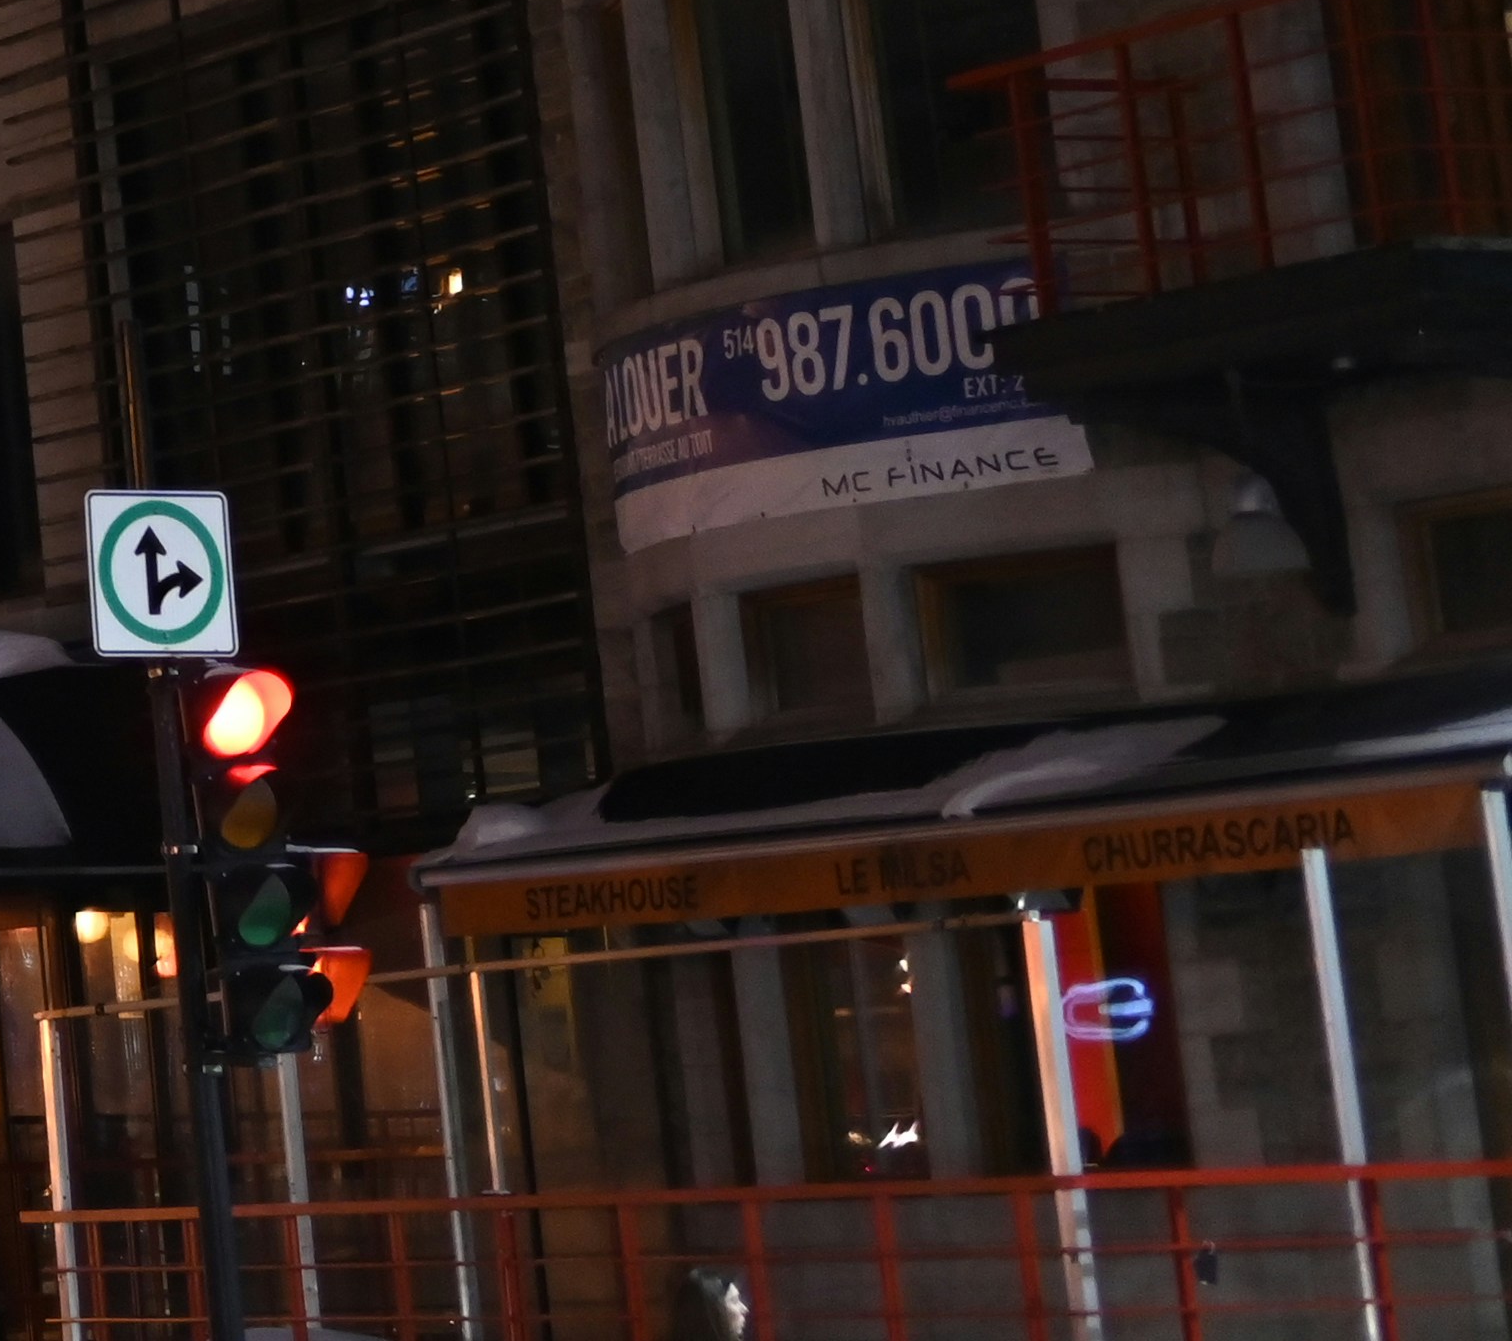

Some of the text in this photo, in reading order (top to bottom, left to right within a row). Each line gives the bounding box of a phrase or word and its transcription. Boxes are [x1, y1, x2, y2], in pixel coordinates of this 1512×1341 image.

[722, 323, 754, 360] 514
[619, 339, 708, 439] LOUER
[822, 471, 873, 497] MC
[524, 872, 701, 922] STEAKHOUSE
[834, 859, 869, 896] LE
[1081, 808, 1358, 873] CHURRASCARIA
